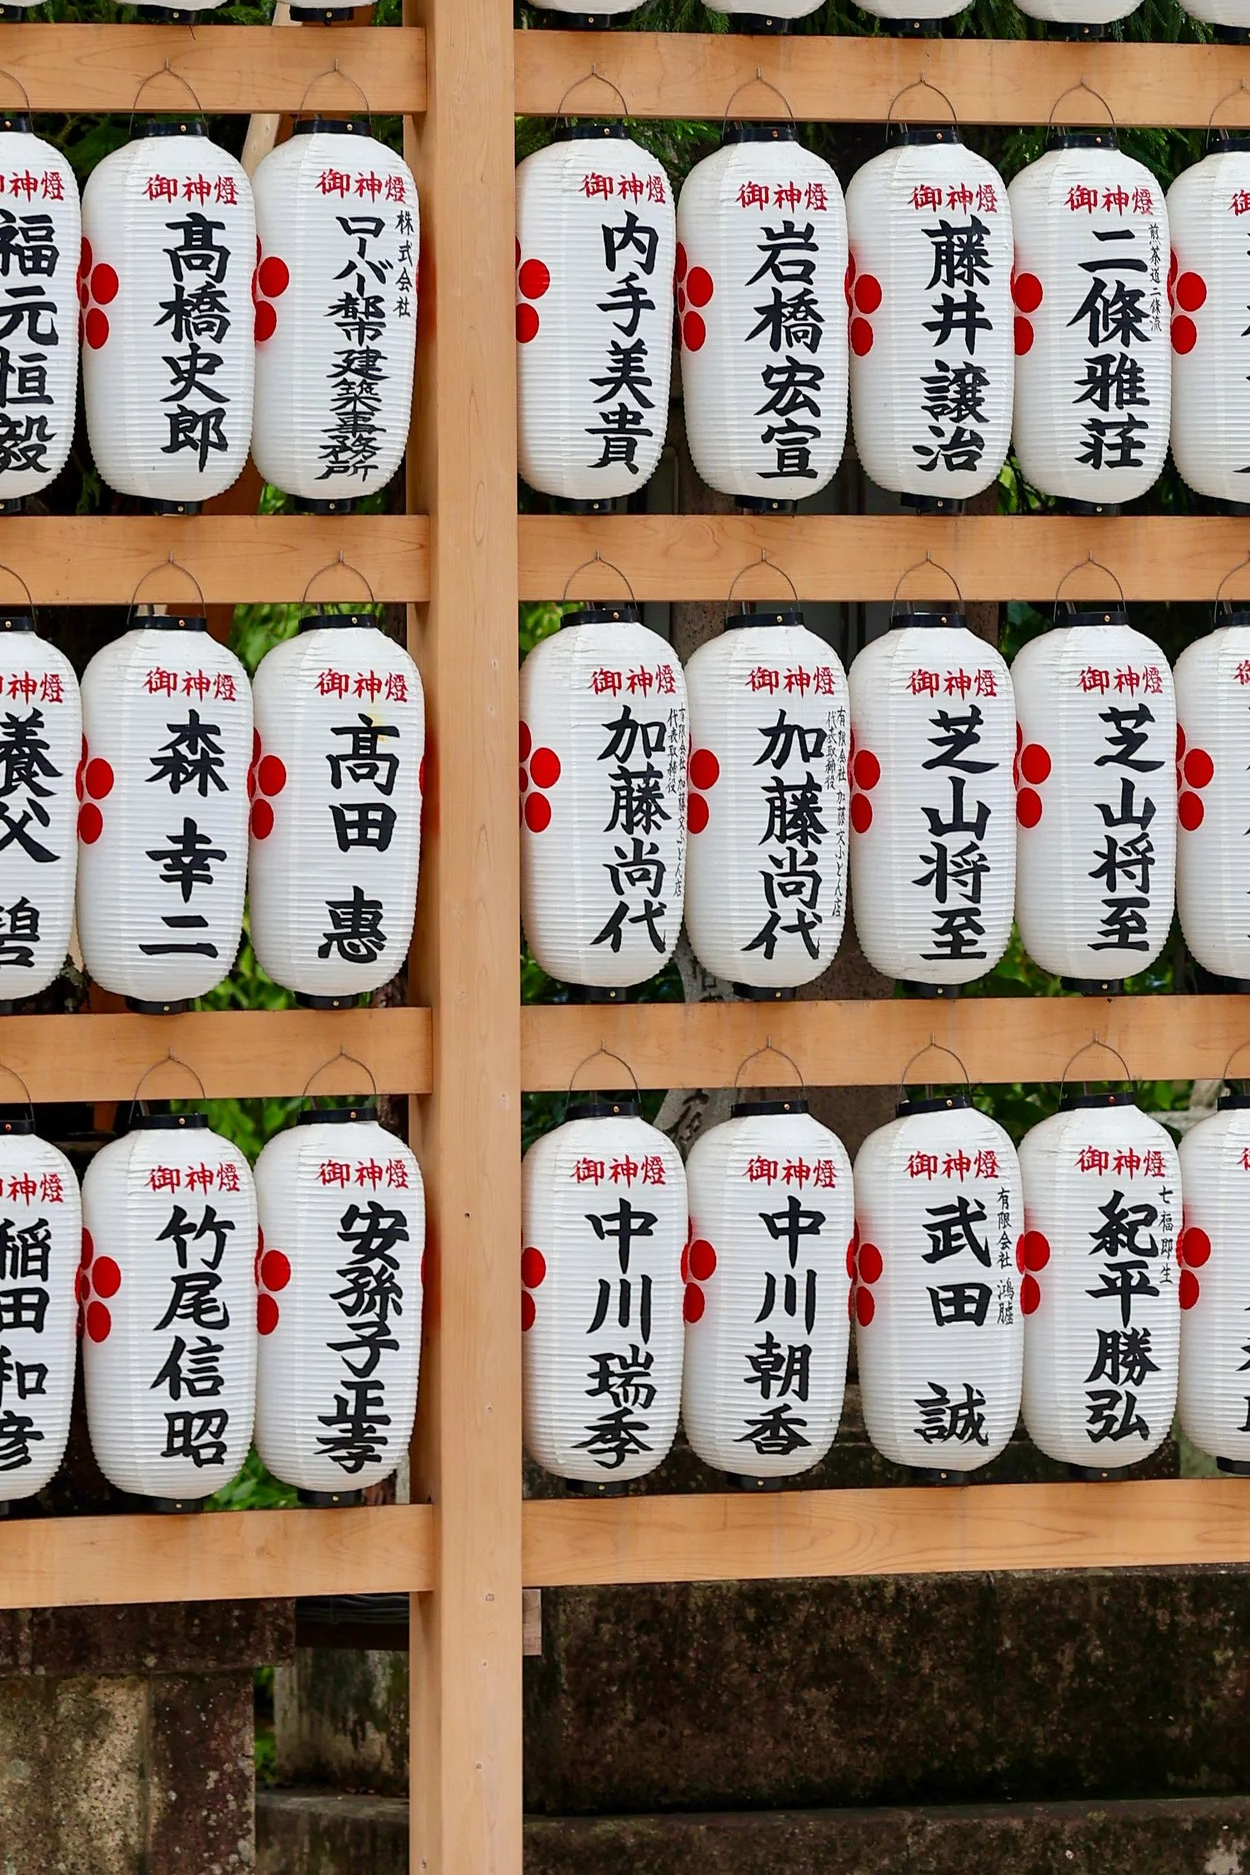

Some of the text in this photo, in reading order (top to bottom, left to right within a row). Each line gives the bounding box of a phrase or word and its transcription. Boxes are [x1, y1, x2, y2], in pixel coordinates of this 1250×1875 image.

[0, 170, 64, 200] 神燈
[145, 174, 236, 205] 御神燈
[319, 168, 406, 202] 御神燈
[584, 173, 664, 203] 御神燈
[738, 181, 827, 211] 御神燈
[912, 183, 996, 212] 御神燈
[1067, 184, 1152, 214] 御神燈
[392, 209, 416, 320] 株式会社
[315, 217, 392, 483] ローバー都市建築事務所
[585, 210, 660, 477] 内手美貴
[745, 220, 825, 479] 岩橋宏宣
[912, 213, 993, 471] 藤井譲治
[1066, 228, 1151, 470] 二條雅荘
[0, 671, 64, 703] 神燈
[145, 667, 235, 701] 御神燈
[317, 669, 408, 702] 御神燈
[592, 664, 675, 696] 御神燈
[748, 666, 833, 696] 御神燈
[909, 669, 997, 698] 御神燈
[1079, 666, 1162, 693] 御神燈
[139, 709, 229, 958] 森幸二
[590, 705, 671, 954] 加藤尚代
[741, 709, 829, 960] 加藤尚代
[912, 704, 1001, 963] 芝山将至
[1087, 703, 1167, 954] 芝山将至
[148, 1163, 240, 1194] 御神燈
[319, 1158, 408, 1189] 御神燈
[574, 1154, 665, 1186] 御神燈
[746, 1156, 836, 1188] 御神燈
[907, 1149, 999, 1180] 御神燈
[1076, 1146, 1165, 1178] 御神燈
[0, 1173, 63, 1204] 神燈
[1158, 1183, 1174, 1287] 七福即生
[733, 1196, 829, 1459] 中川朝香
[914, 1196, 992, 1446] 武田誠
[1084, 1190, 1161, 1443] 紀平勝弘
[150, 1205, 235, 1468] 竹尾信昭
[314, 1201, 410, 1475] 安孫子正孝
[570, 1198, 661, 1471] 中川瑞季
